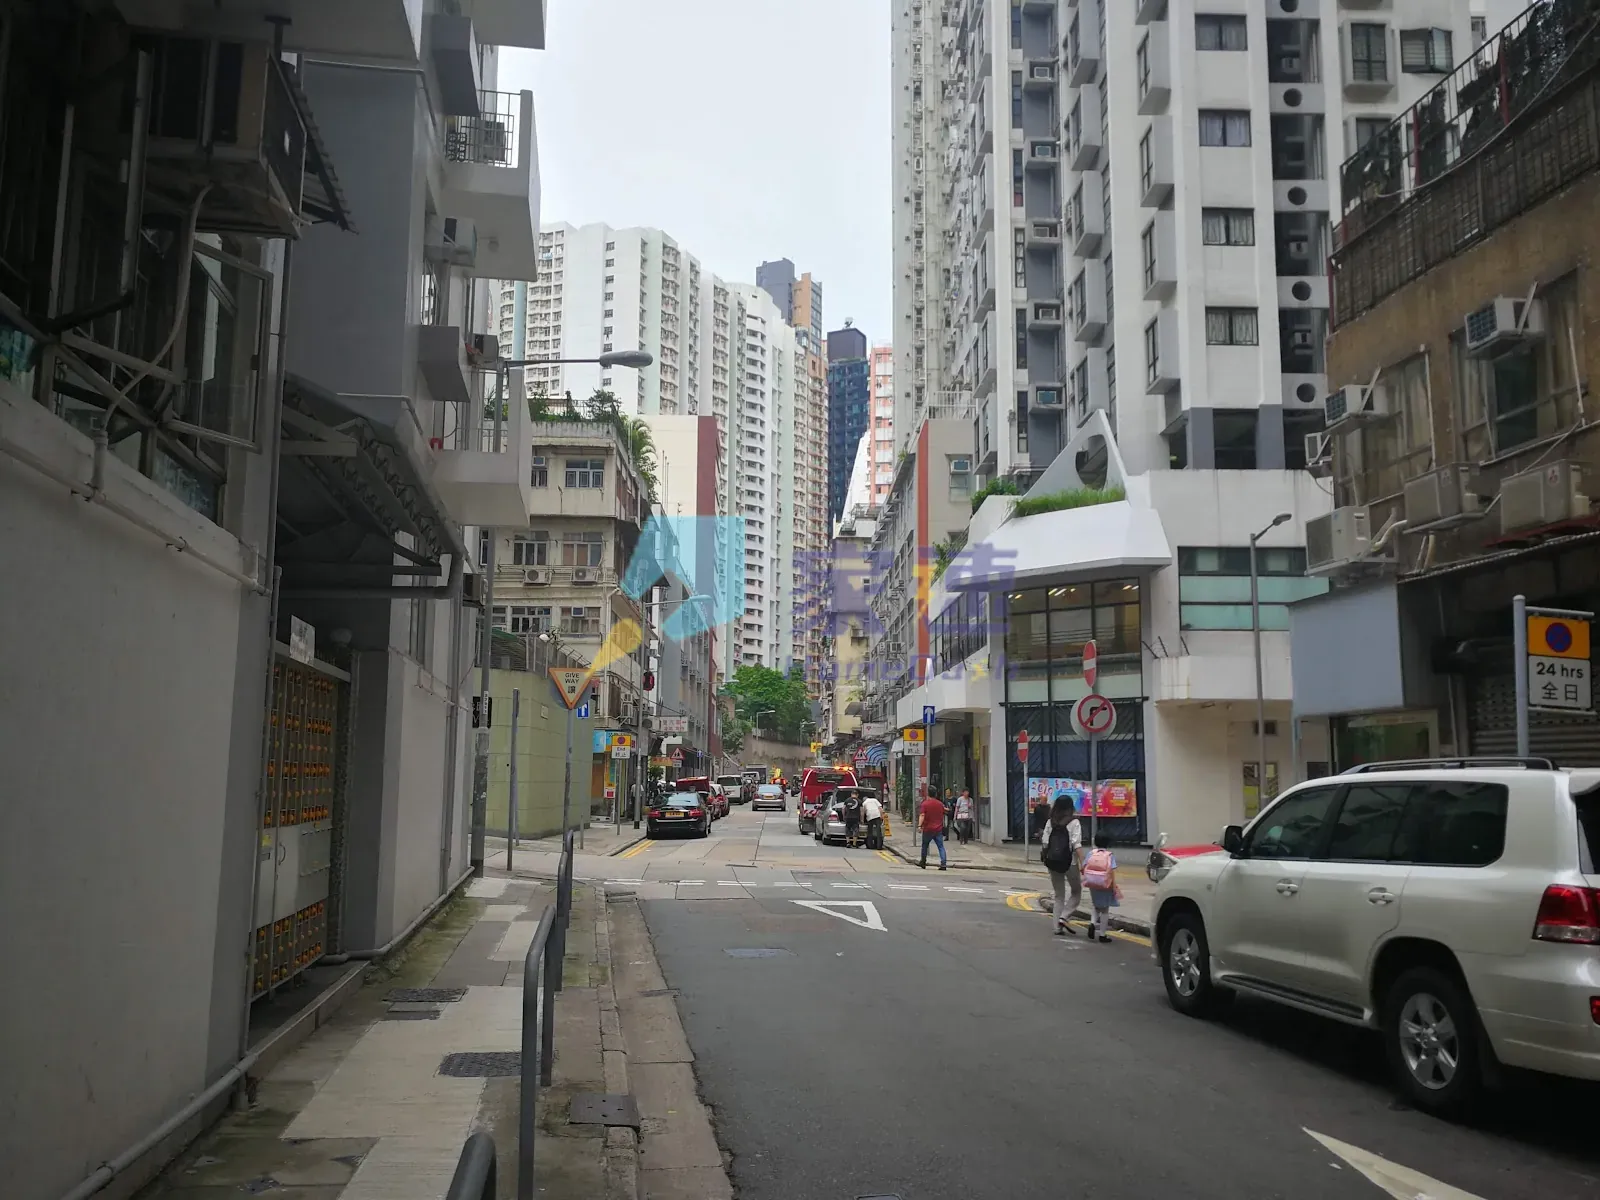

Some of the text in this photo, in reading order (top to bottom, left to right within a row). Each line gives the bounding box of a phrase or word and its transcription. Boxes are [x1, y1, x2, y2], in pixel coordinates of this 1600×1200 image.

[1536, 661, 1584, 679] 24 hrs
[1541, 681, 1578, 702] 全日
[1031, 781, 1053, 796] 2019
